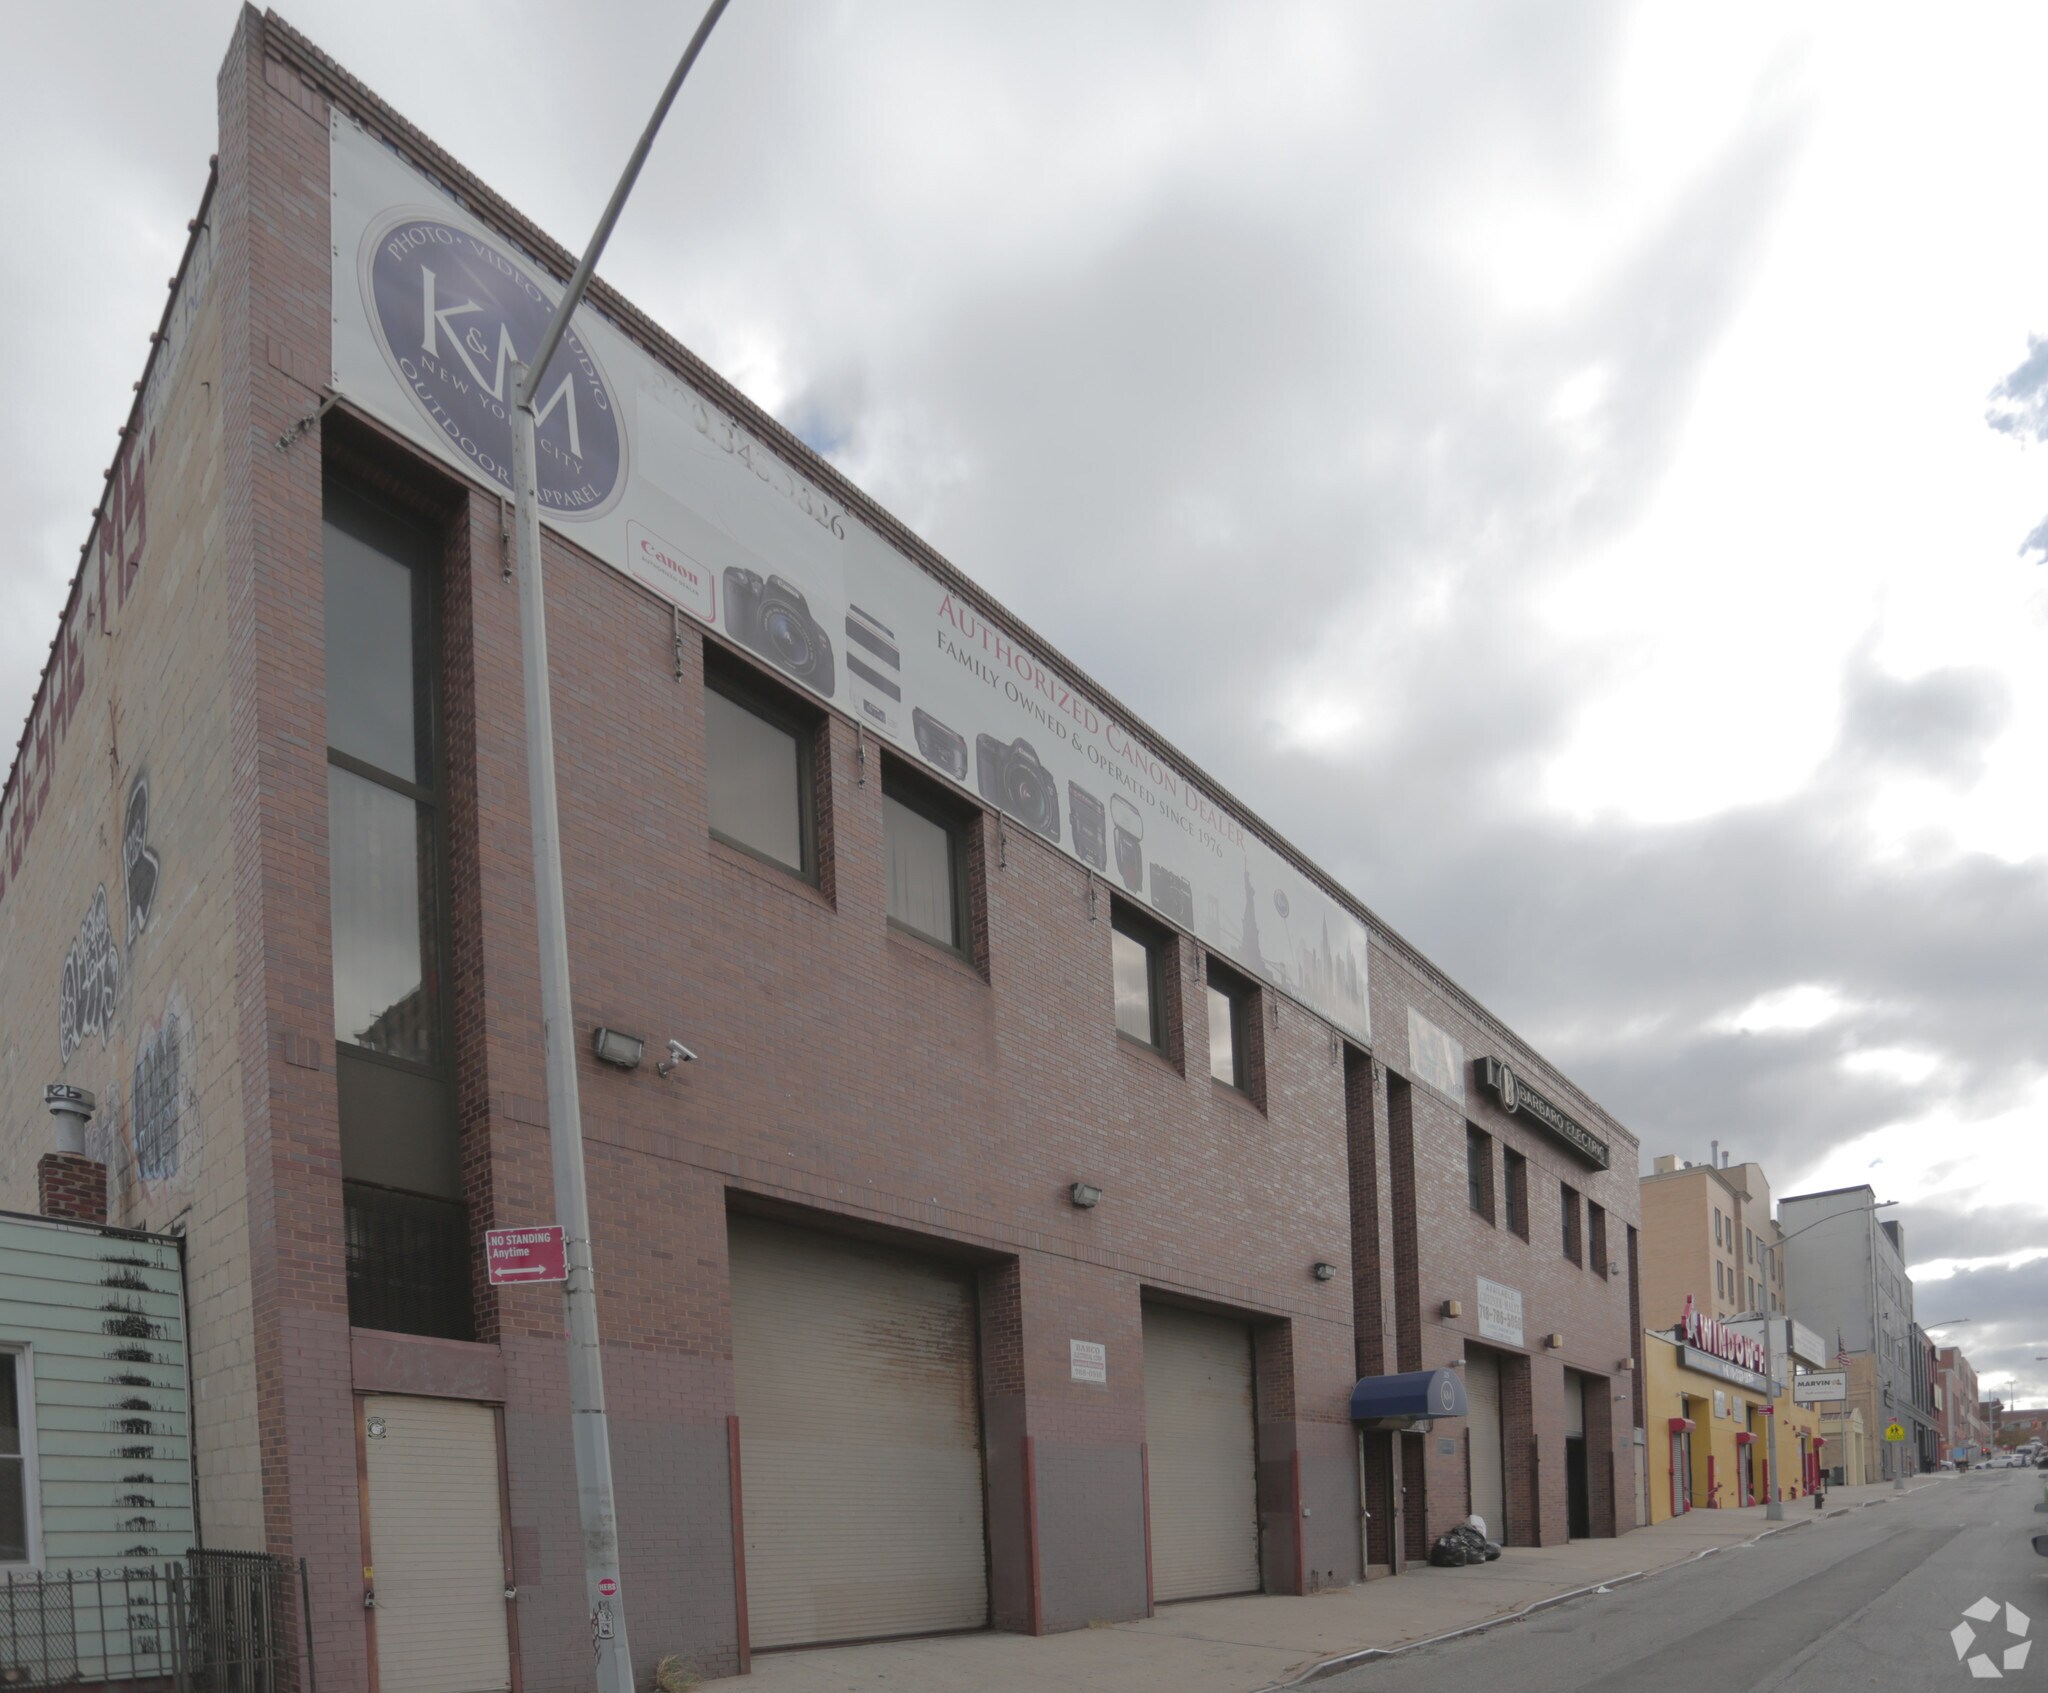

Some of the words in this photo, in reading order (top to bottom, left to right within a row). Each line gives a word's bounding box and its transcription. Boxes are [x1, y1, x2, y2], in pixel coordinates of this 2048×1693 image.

[388, 226, 452, 263] PHOTO
[470, 240, 542, 303] VIDEO
[563, 329, 607, 411] UDIO
[400, 358, 512, 486] OUTDOOR
[421, 356, 469, 395] NEW
[540, 438, 583, 475] CITY
[640, 540, 699, 587] Canon
[937, 629, 1000, 689] FAMILY
[1004, 681, 1067, 740] OWNED
[1071, 732, 1083, 754] &
[1087, 744, 1156, 807] OPERATED
[1159, 800, 1195, 837] SINCE
[1198, 828, 1223, 858] 1976
[938, 595, 1099, 735] AUTHORIZED
[1105, 723, 1178, 798] CANON
[1184, 784, 1246, 853] DEALER
[1518, 1085, 1564, 1130] BARBARO
[1566, 1120, 1606, 1162] ELECTRIC
[491, 1236, 504, 1246] NO
[506, 1232, 551, 1245] STANDING
[493, 1247, 530, 1260] Anytime
